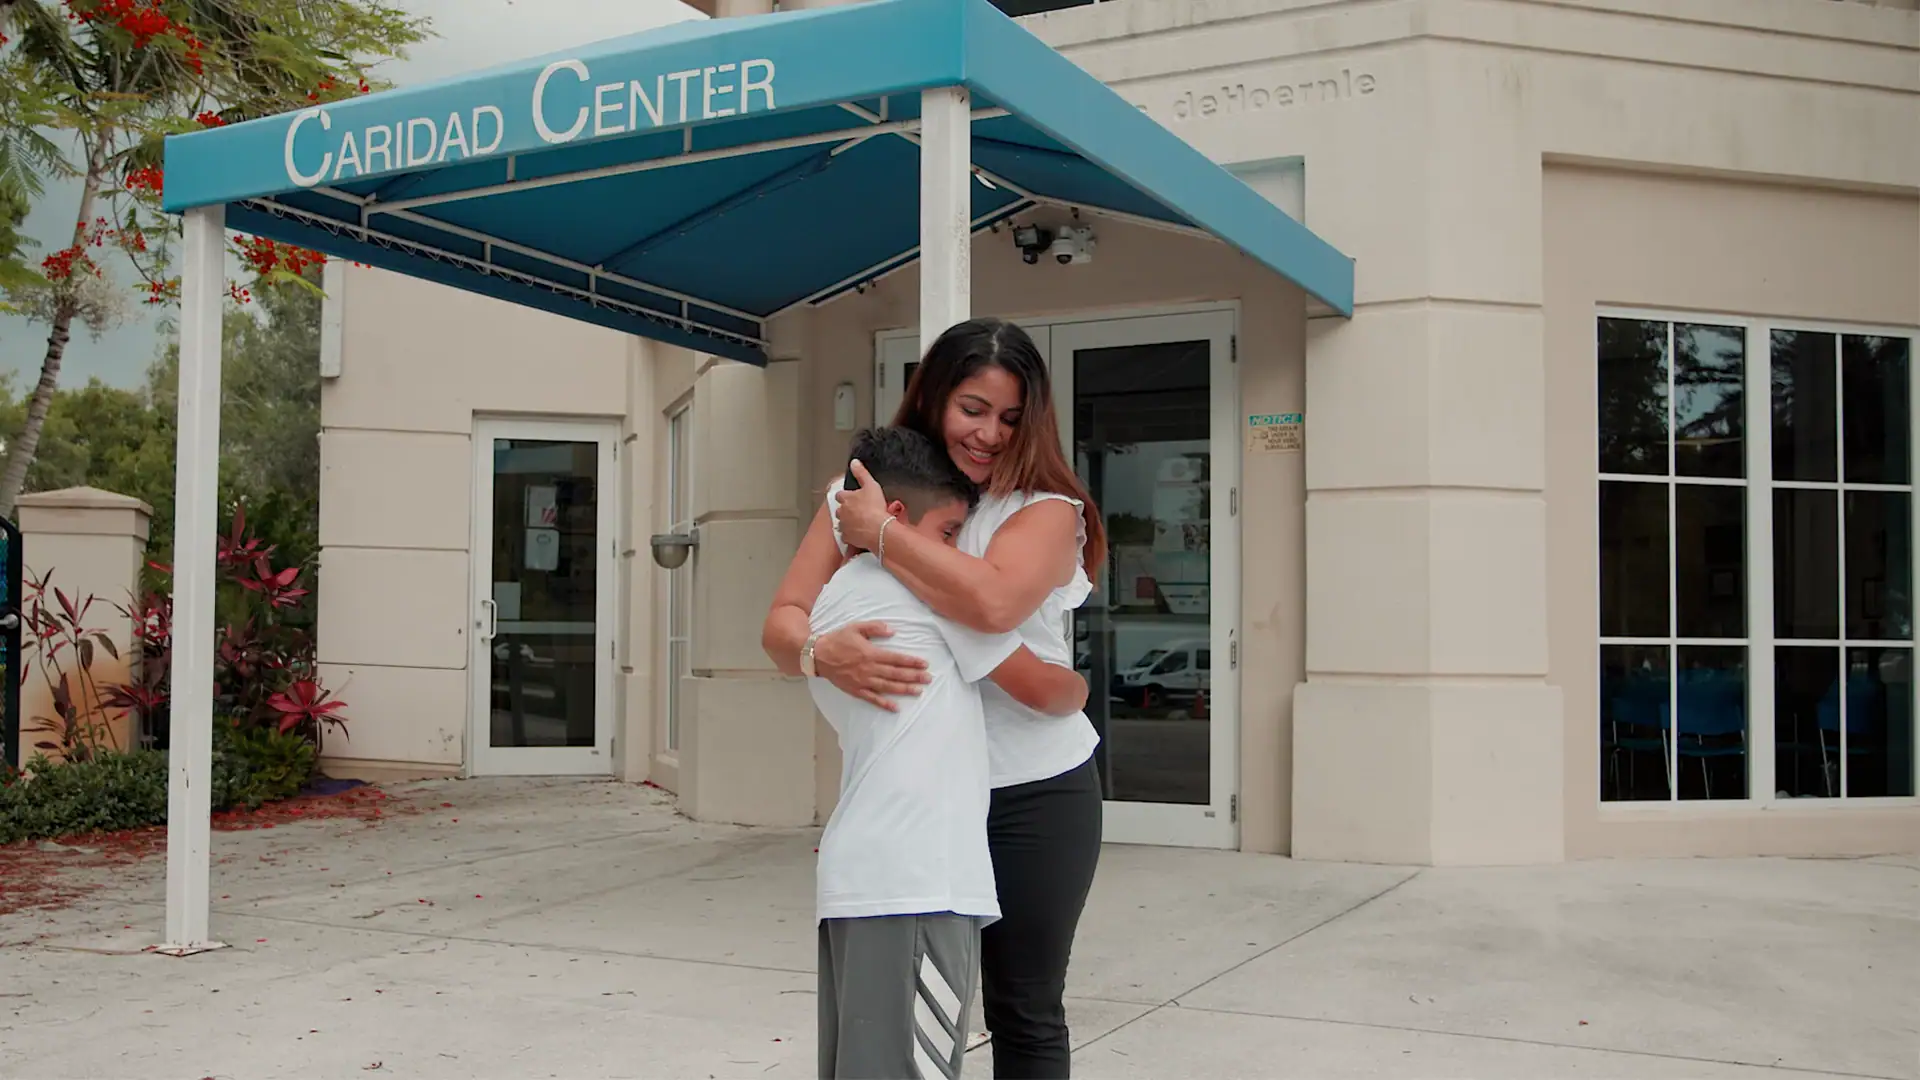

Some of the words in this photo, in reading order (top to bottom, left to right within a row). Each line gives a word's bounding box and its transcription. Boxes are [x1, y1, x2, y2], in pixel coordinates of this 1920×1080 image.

[1172, 69, 1377, 119] deHoernle
[284, 105, 504, 188] CARIDAD
[531, 58, 776, 145] CENTER
[1251, 415, 1299, 426] NOTICE
